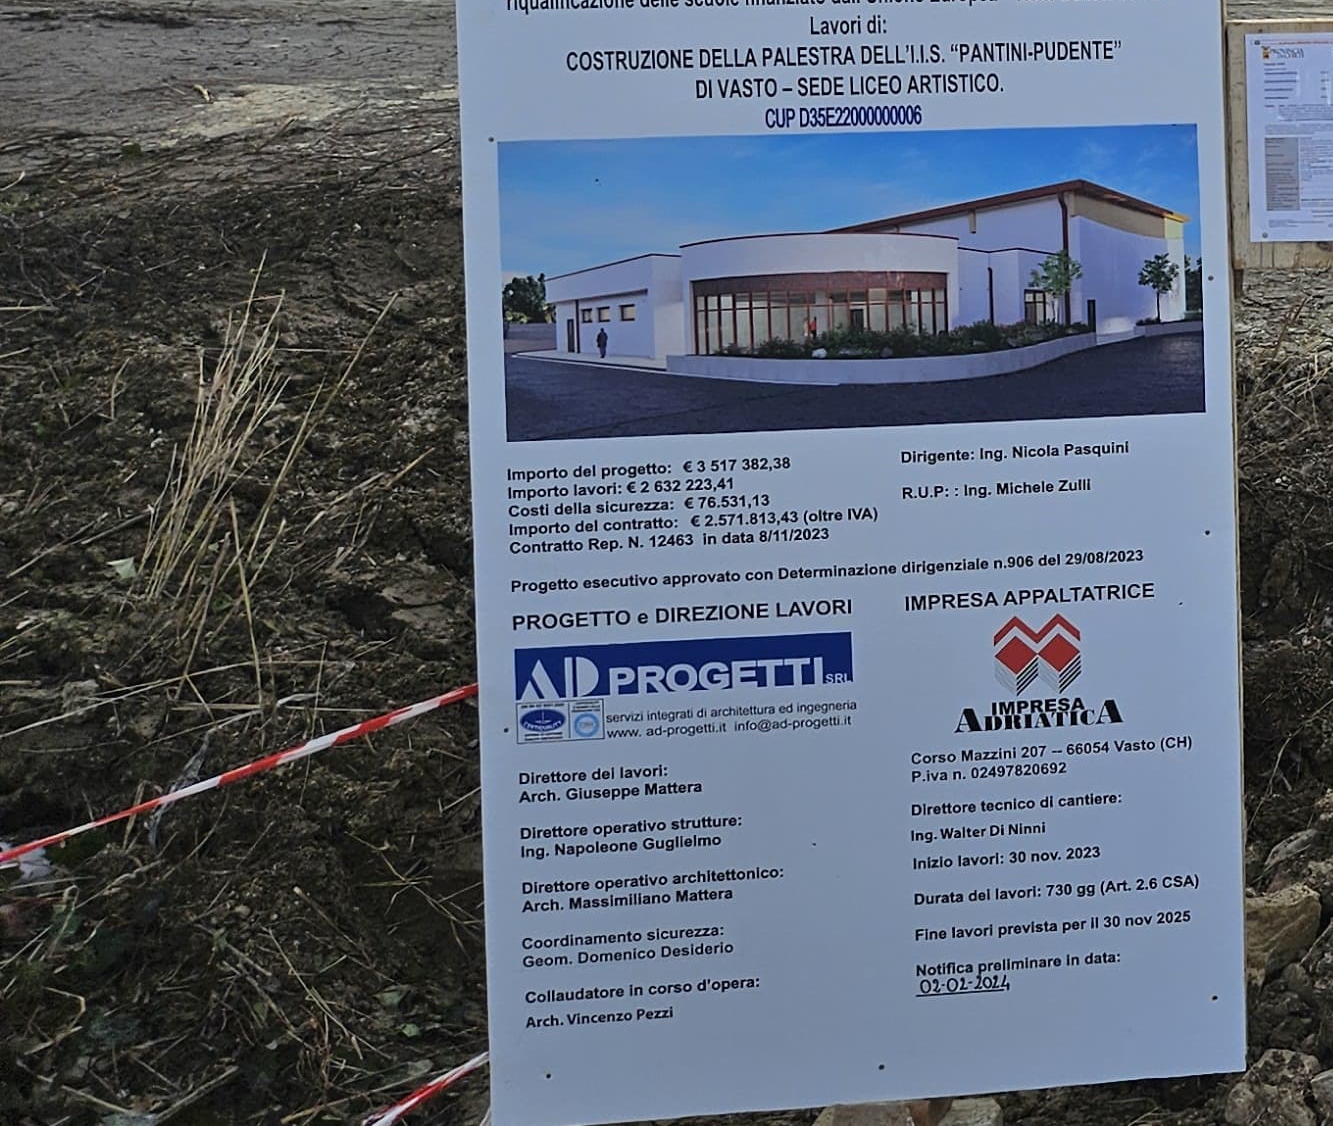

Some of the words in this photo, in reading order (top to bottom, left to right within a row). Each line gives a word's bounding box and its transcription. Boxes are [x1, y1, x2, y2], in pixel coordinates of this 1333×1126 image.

[810, 14, 861, 35] Lavori
[866, 14, 886, 34] di:
[566, 48, 694, 71] COSTRUZIONE
[699, 47, 757, 68] DELLA
[762, 45, 855, 67] PALESTRA
[695, 79, 712, 98] DI
[717, 77, 777, 98] VASTO
[797, 76, 844, 96] SEDE
[849, 74, 901, 95] LICEO
[906, 72, 1003, 94] ARTISTICO.
[765, 107, 795, 128] CUP
[799, 104, 922, 127] D35E22000000006
[900, 449, 974, 465] Dirigente:
[979, 447, 1007, 462] Ing.
[1012, 444, 1059, 458] Nicola
[1064, 440, 1128, 457] Pasquini
[509, 539, 583, 554] Contratto
[588, 537, 623, 552] Rep.
[627, 535, 644, 548] N.
[648, 533, 693, 547] 12463
[702, 532, 716, 545] in
[721, 531, 754, 544] data
[759, 527, 829, 542] 8/11/2023
[511, 578, 578, 594] Progetto
[582, 573, 657, 588] esecutivo
[662, 570, 740, 588] approvato
[745, 570, 773, 581] con
[778, 563, 896, 579] Determinazione
[901, 557, 988, 575] dirigenziale
[993, 555, 1033, 569] n.906
[1038, 553, 1060, 566] del
[1065, 549, 1143, 565] 29/08/2023
[905, 591, 999, 611] IMPRESA
[1002, 582, 1155, 606] APPALTATRICE
[512, 609, 630, 631] PROGETTO
[637, 612, 648, 624] e
[655, 603, 769, 623] DIREZIONE
[775, 598, 851, 617] LAVORI
[608, 656, 824, 696] PROGETTI
[606, 709, 644, 723] servizi
[646, 709, 693, 722] integrati
[696, 707, 707, 718] di
[710, 705, 775, 717] architettura
[778, 703, 793, 714] ed
[796, 701, 856, 715] ingegneria
[953, 699, 1125, 734] ADRIATICA
[991, 697, 1085, 716] IMPRESA
[606, 725, 641, 739] www.
[645, 722, 726, 737] ad-progetti.it
[734, 715, 851, 732] info@ad-progetti.it
[911, 769, 947, 783] P.iva
[952, 770, 966, 780] n.
[970, 761, 1066, 778] 02497820692
[518, 789, 560, 803] Arch.
[565, 786, 640, 800] Giuseppe
[644, 782, 702, 795] Mattera
[911, 802, 976, 816] Direttore
[980, 797, 1035, 812] tecnico
[1039, 795, 1053, 808] di
[1058, 792, 1121, 807] cantiere:
[520, 825, 588, 839] Direttore
[592, 819, 666, 837] operativo
[671, 816, 742, 830] strutture:
[910, 829, 938, 843] Ing.
[939, 826, 986, 839] Walter
[989, 823, 1004, 836] Di
[1008, 821, 1045, 835] Ninni
[520, 845, 549, 860] Ing.
[554, 840, 637, 857] Napoleone
[642, 834, 721, 851] Guglielmo
[913, 855, 953, 870] Inizio
[957, 852, 1003, 867] lavori:
[1008, 850, 1026, 863] 30
[1030, 851, 1061, 862] nov.
[1065, 846, 1100, 860] 2023
[521, 880, 589, 894] Direttore
[594, 874, 667, 892] operativo
[672, 866, 783, 884] architettonico:
[521, 898, 564, 913] Arch.
[569, 892, 671, 910] Massimiliano
[675, 889, 733, 902] Mattera
[521, 930, 642, 950] Coordinamento
[646, 926, 723, 941] sicurezza:
[522, 955, 572, 967] Geom.
[577, 947, 655, 964] Domenico
[660, 941, 733, 958] Desiderio
[916, 961, 973, 977] Notifica
[978, 956, 1062, 975] preliminare
[1066, 953, 1079, 966] in
[1084, 951, 1120, 965] data:
[525, 987, 624, 1004] Collaudatore
[629, 984, 643, 997] in
[648, 982, 692, 995] corso
[525, 1014, 564, 1028] Arch.
[566, 1012, 632, 1025] Vincenzo
[636, 1006, 673, 1020] Pezzi
